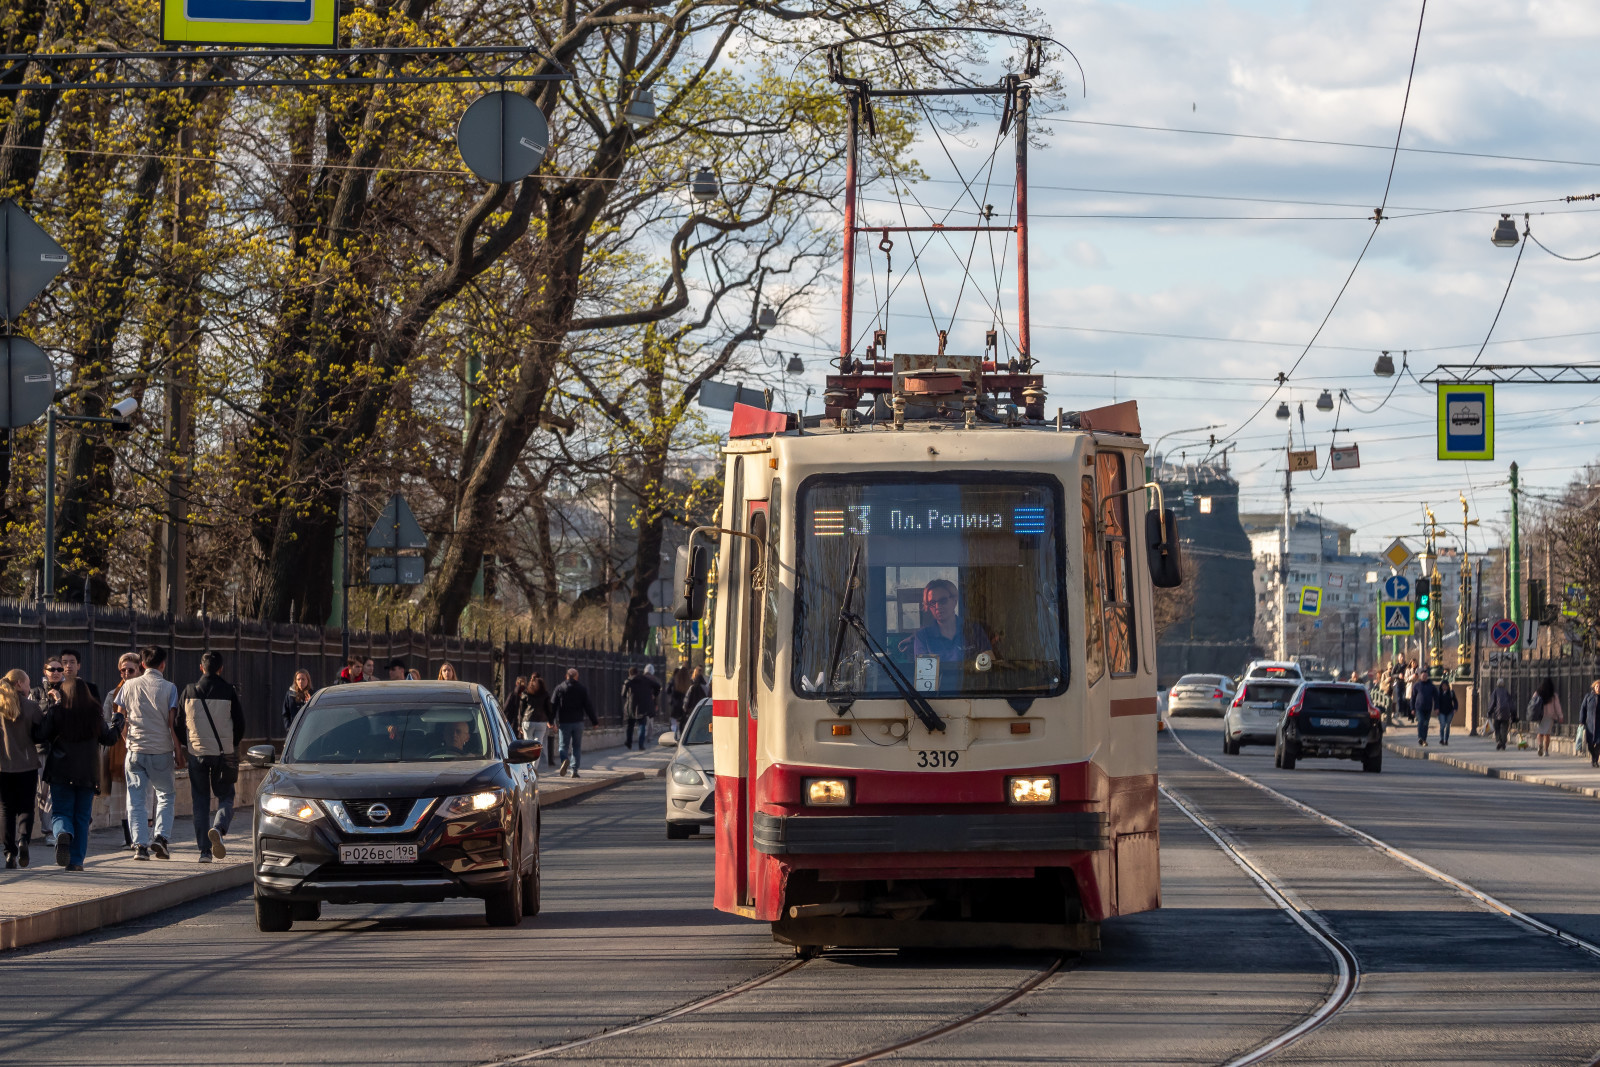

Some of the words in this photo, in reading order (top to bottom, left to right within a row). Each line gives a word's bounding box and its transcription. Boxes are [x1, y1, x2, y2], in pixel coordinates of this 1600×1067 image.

[848, 505, 871, 535] 3
[925, 658, 934, 671] 3
[923, 680, 933, 692] 9
[917, 750, 960, 768] 3319
[396, 846, 414, 856] 198
